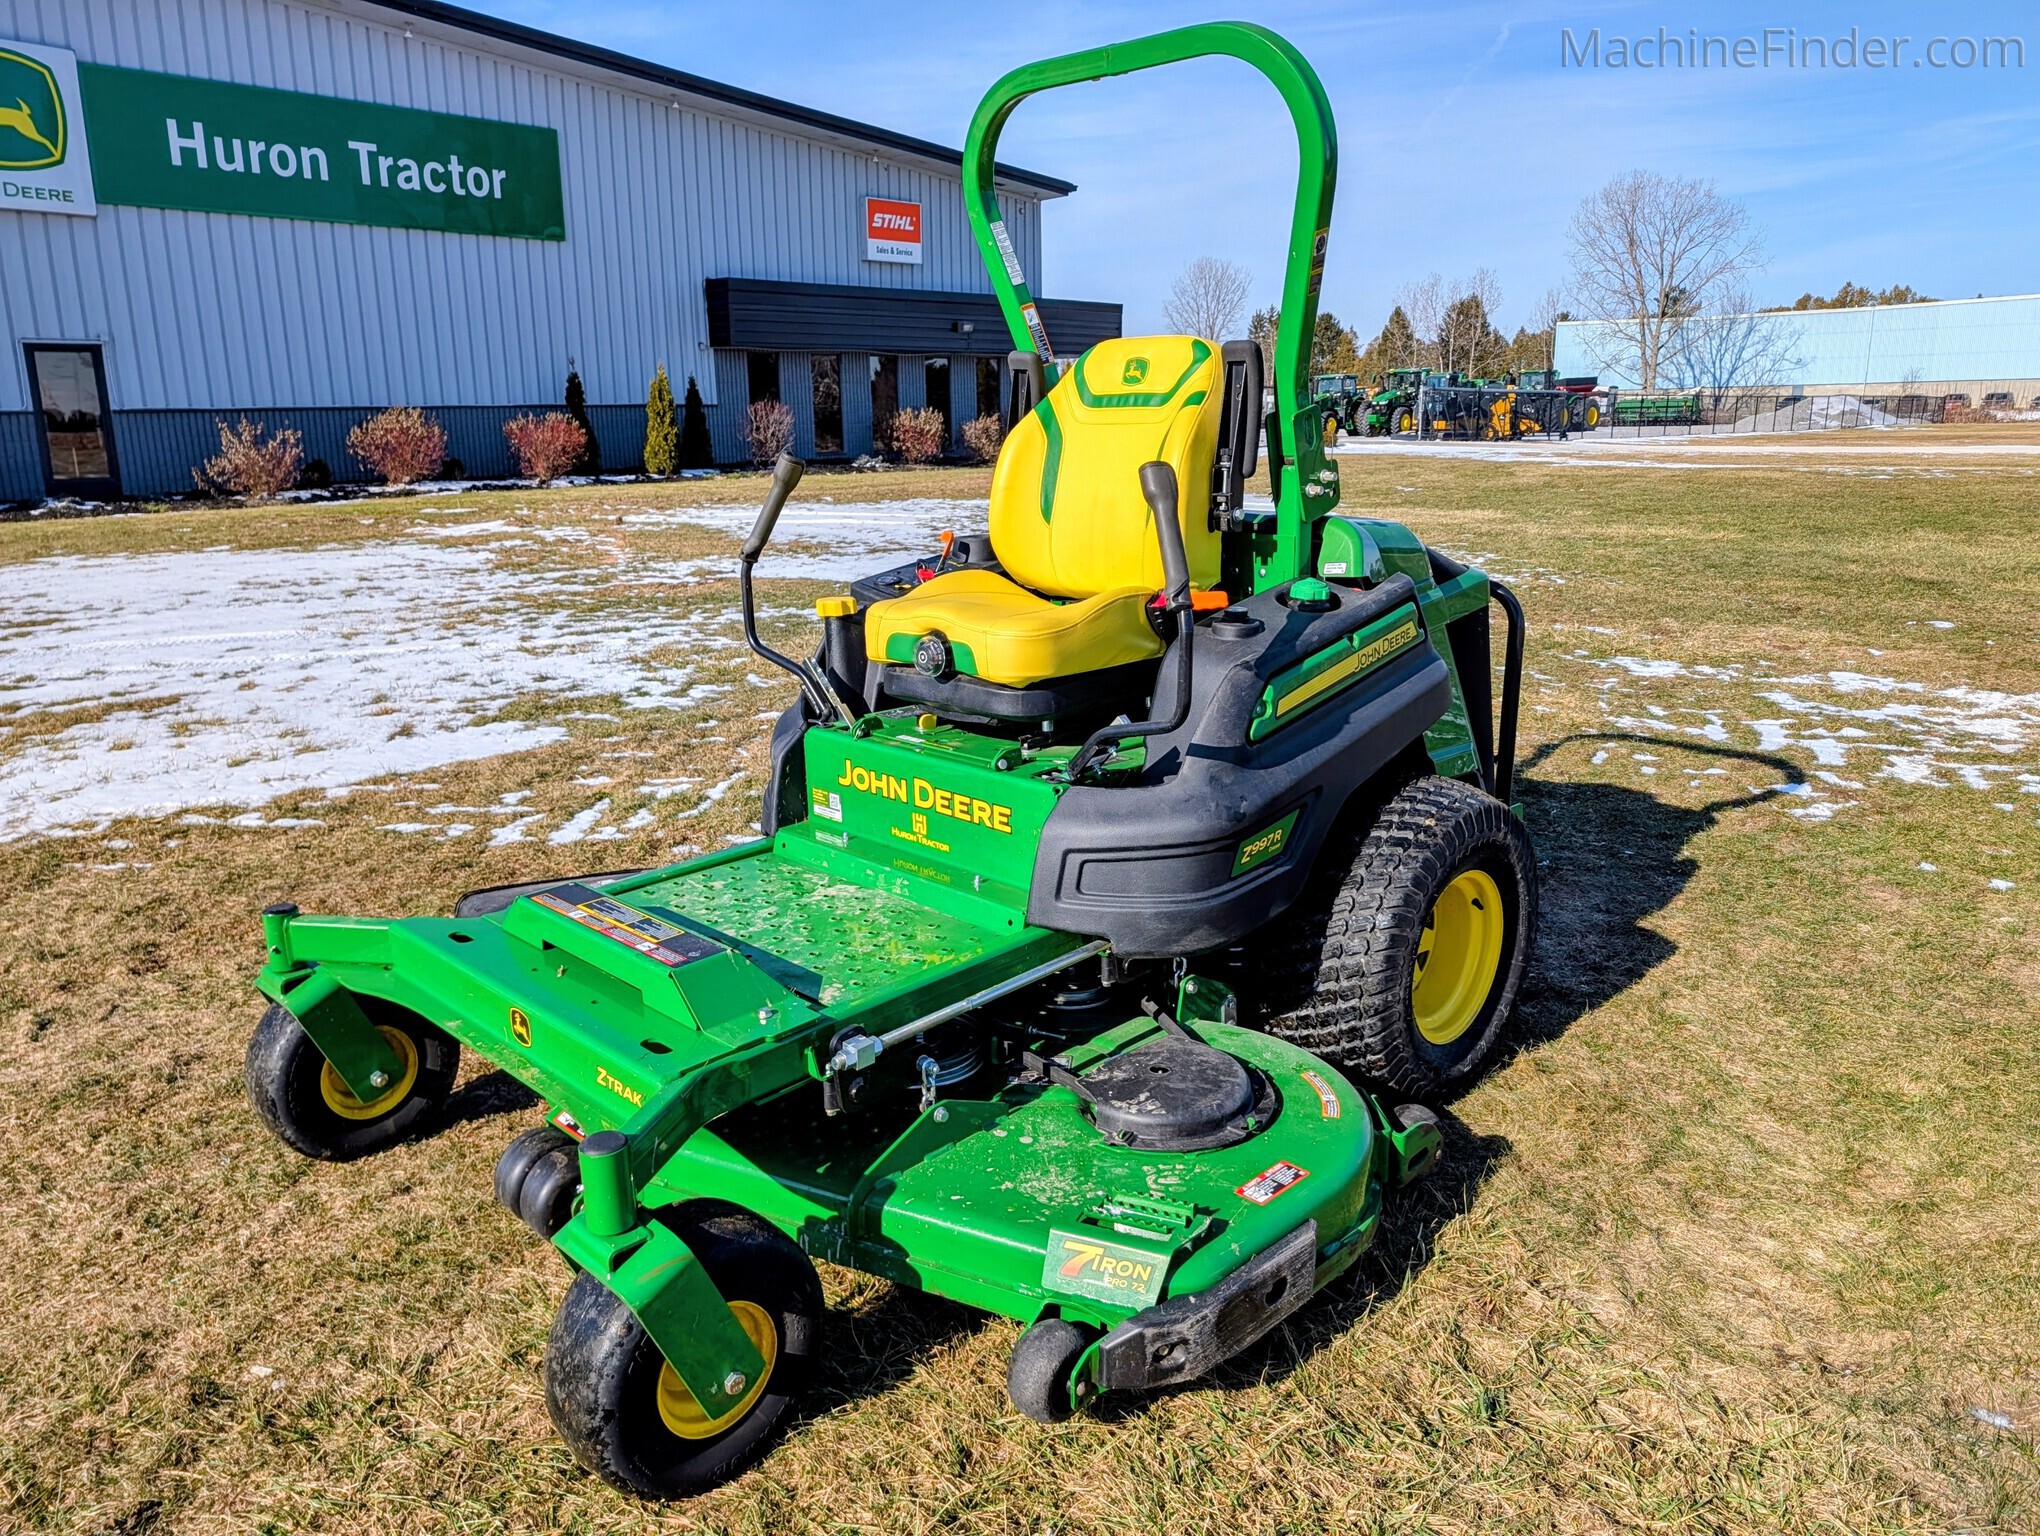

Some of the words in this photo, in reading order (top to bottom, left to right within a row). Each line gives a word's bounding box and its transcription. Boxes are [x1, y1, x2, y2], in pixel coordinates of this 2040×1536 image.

[165, 117, 329, 182] Huron
[347, 140, 507, 199] Tractor
[2, 181, 75, 203] DEERE
[871, 212, 915, 231] STIHL
[876, 246, 890, 255] Sales
[890, 246, 895, 255] &
[896, 248, 913, 257] Service
[1354, 644, 1382, 672] JOHN
[1382, 627, 1412, 655] DEERE
[838, 758, 908, 805] JOHN
[912, 776, 1013, 835] DEERE
[1240, 828, 1283, 864] Z997R
[596, 1065, 644, 1108] ZTRAK
[1131, 1281, 1146, 1294] 72
